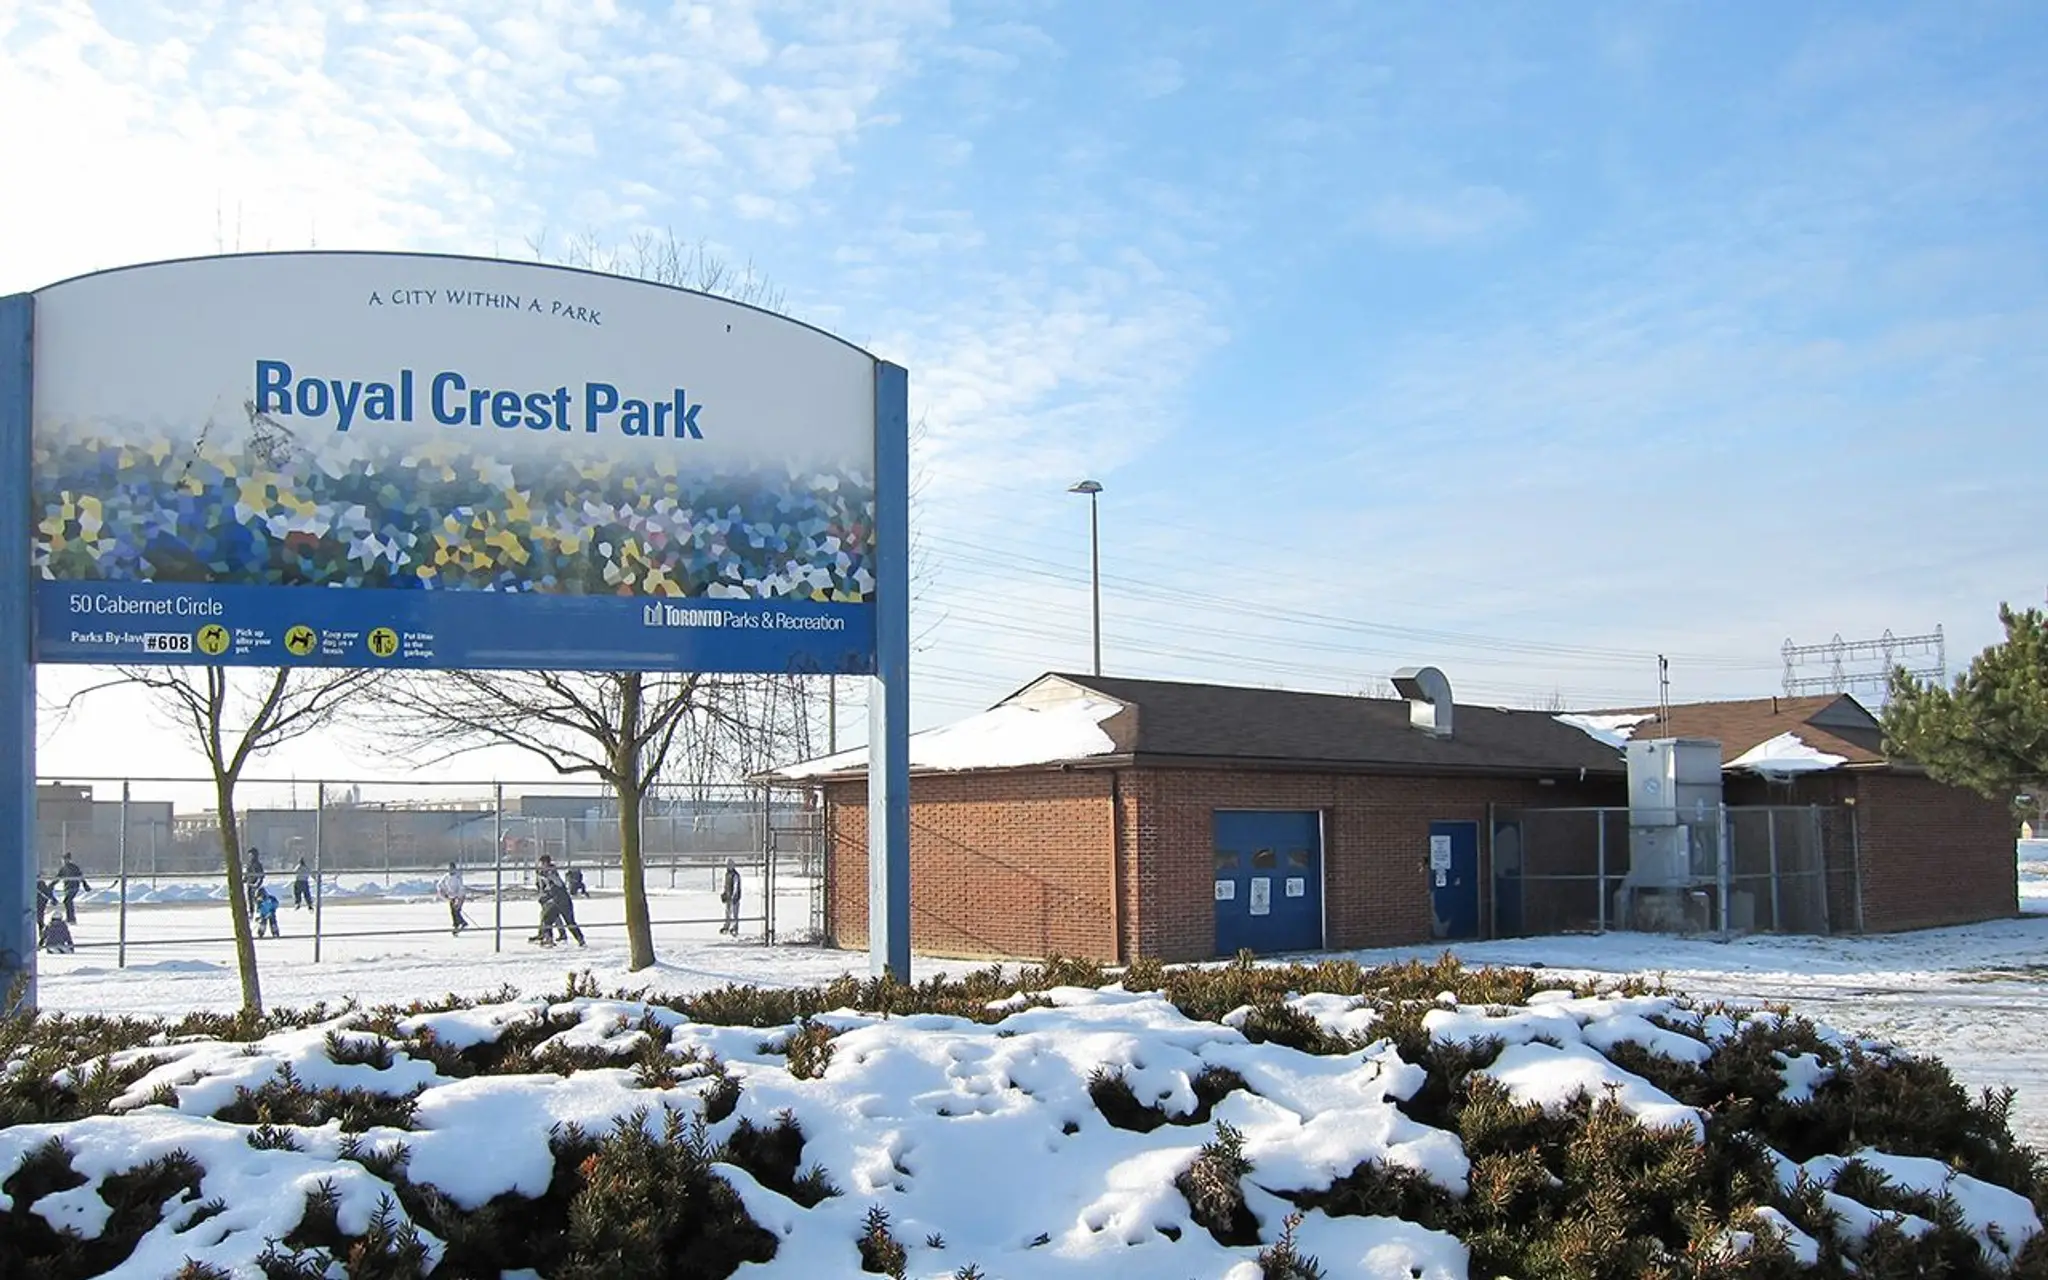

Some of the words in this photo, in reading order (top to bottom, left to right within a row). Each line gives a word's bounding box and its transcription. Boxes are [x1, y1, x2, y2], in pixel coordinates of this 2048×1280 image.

[369, 291, 383, 306] A
[392, 289, 437, 305] CITY
[446, 290, 520, 310] WITHIN
[528, 298, 543, 313] A
[552, 300, 601, 326] PARK
[256, 359, 413, 432] Royal
[431, 371, 571, 431] Crest
[586, 382, 703, 440] Park
[70, 594, 92, 613] 50
[95, 594, 173, 614] Cabernet
[176, 597, 223, 616] Circle
[664, 605, 722, 627] TORONTO
[723, 611, 759, 629] Parks
[762, 613, 775, 629] &
[776, 612, 845, 631] Recreation
[71, 631, 103, 643] Parks
[147, 635, 189, 650] #608
